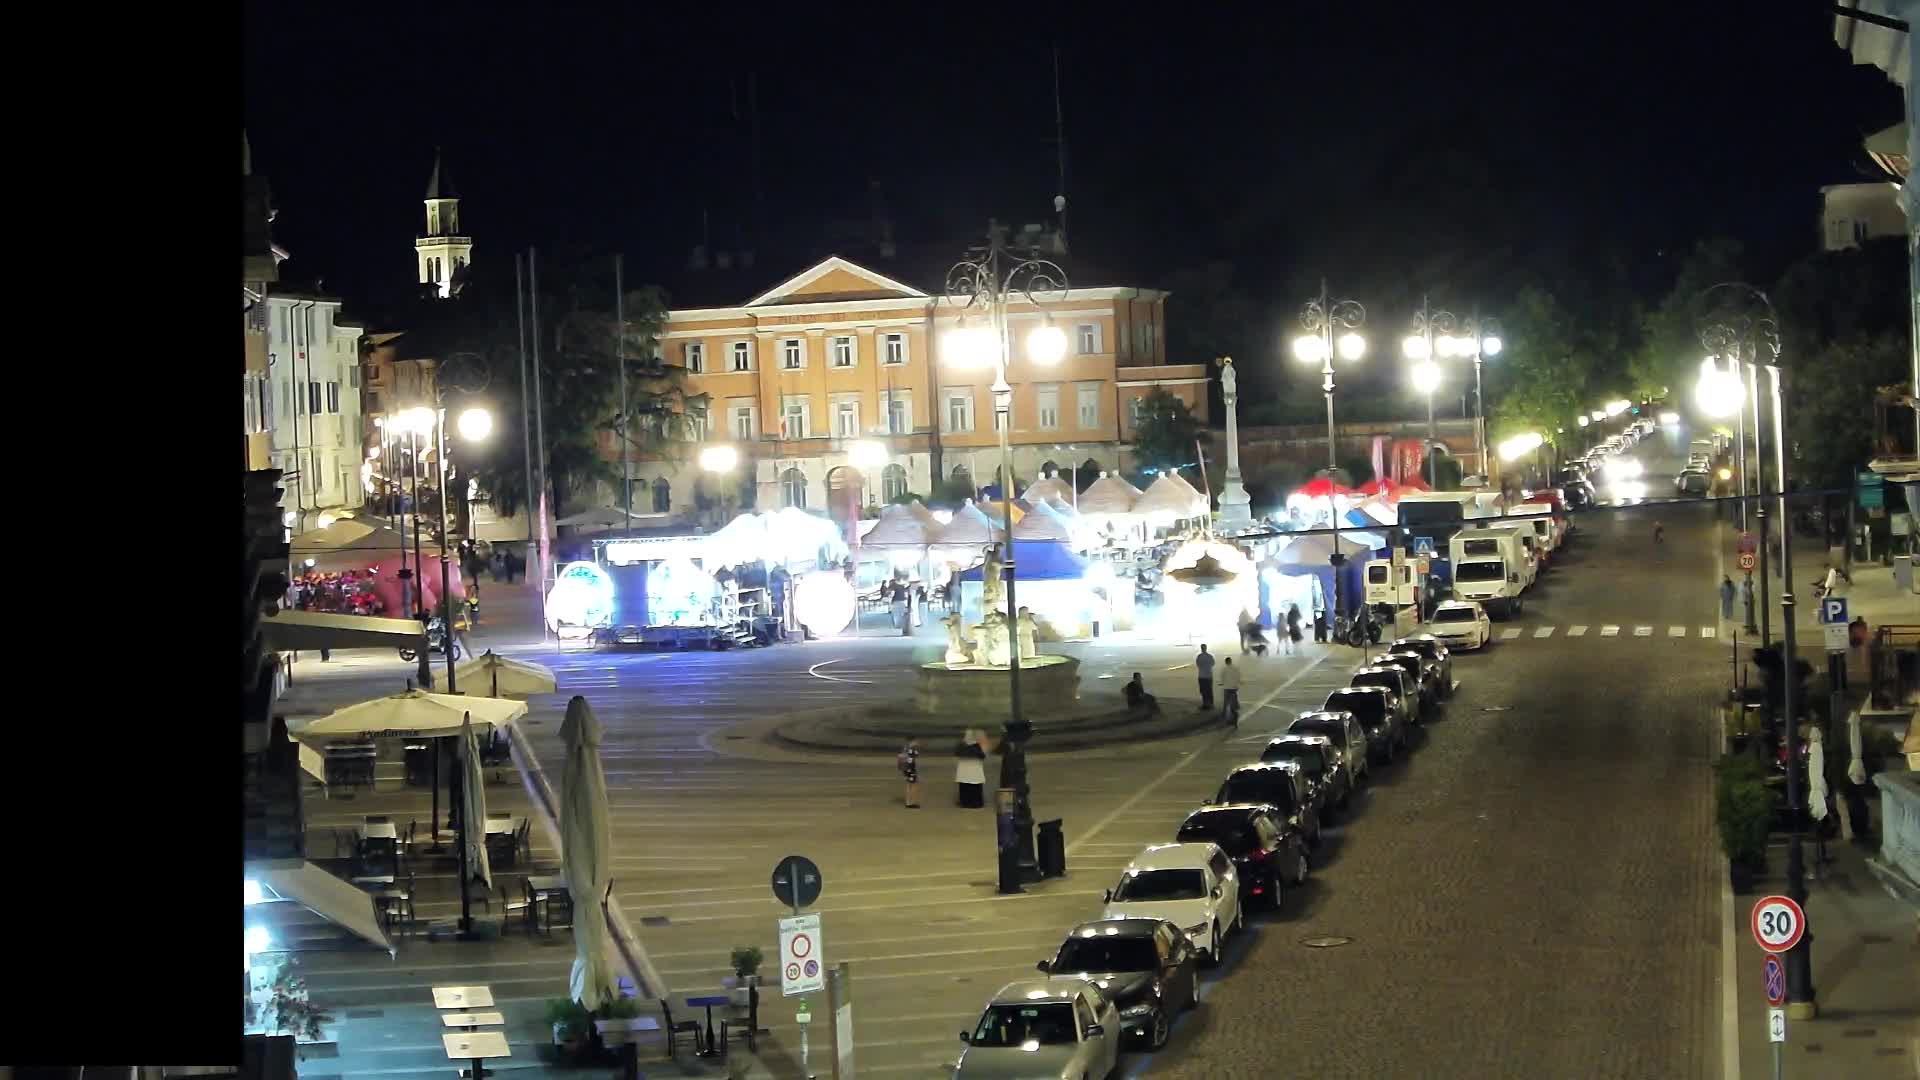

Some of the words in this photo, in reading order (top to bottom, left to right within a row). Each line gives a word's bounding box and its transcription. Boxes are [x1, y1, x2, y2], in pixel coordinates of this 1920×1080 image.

[1743, 557, 1753, 566] 20
[1827, 601, 1842, 621] P
[1762, 911, 1791, 937] 30
